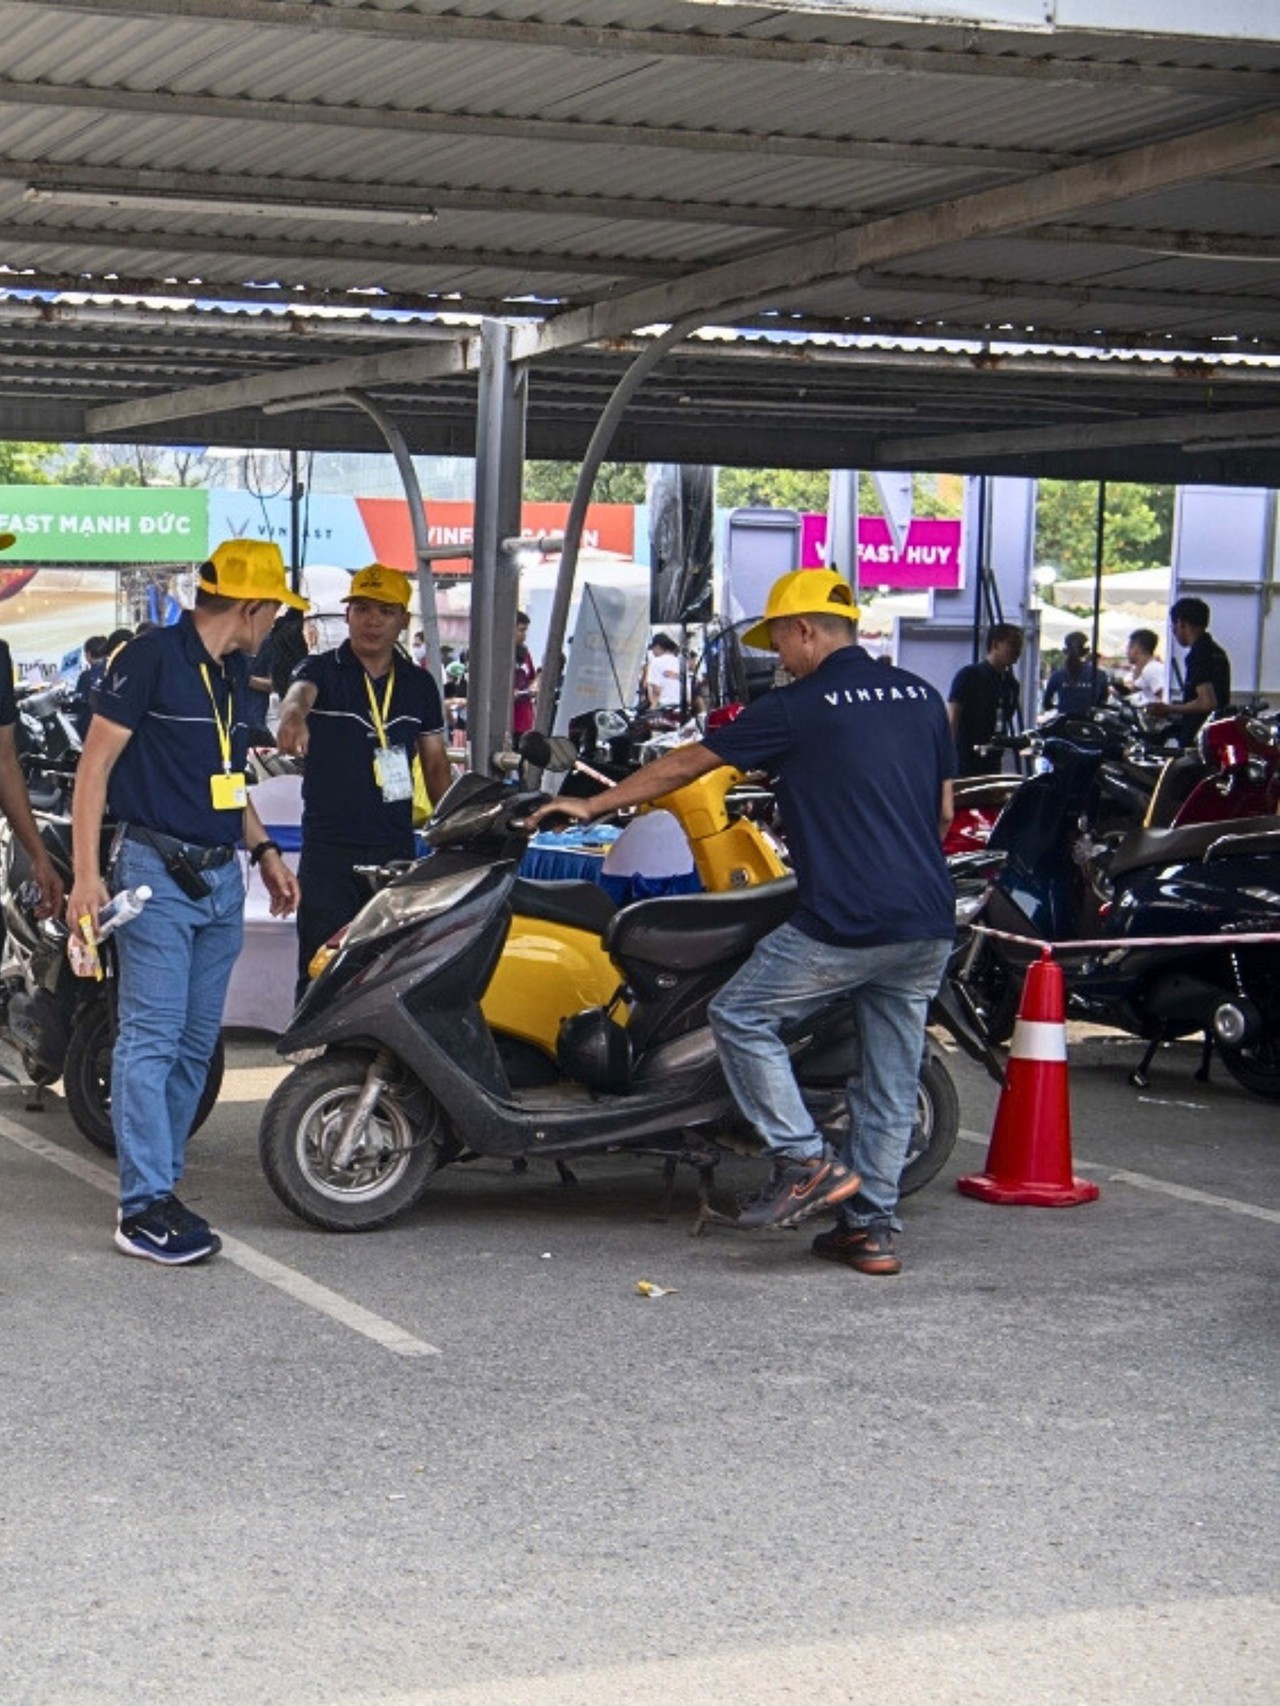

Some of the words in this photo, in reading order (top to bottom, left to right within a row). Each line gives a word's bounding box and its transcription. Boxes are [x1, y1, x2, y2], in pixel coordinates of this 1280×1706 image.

[59, 514, 131, 537] MẠNH
[138, 511, 191, 534] ĐỨC
[258, 525, 332, 539] VINAST
[815, 541, 901, 563] VFAST
[906, 546, 951, 564] HUY
[824, 686, 928, 706] VINFAST
